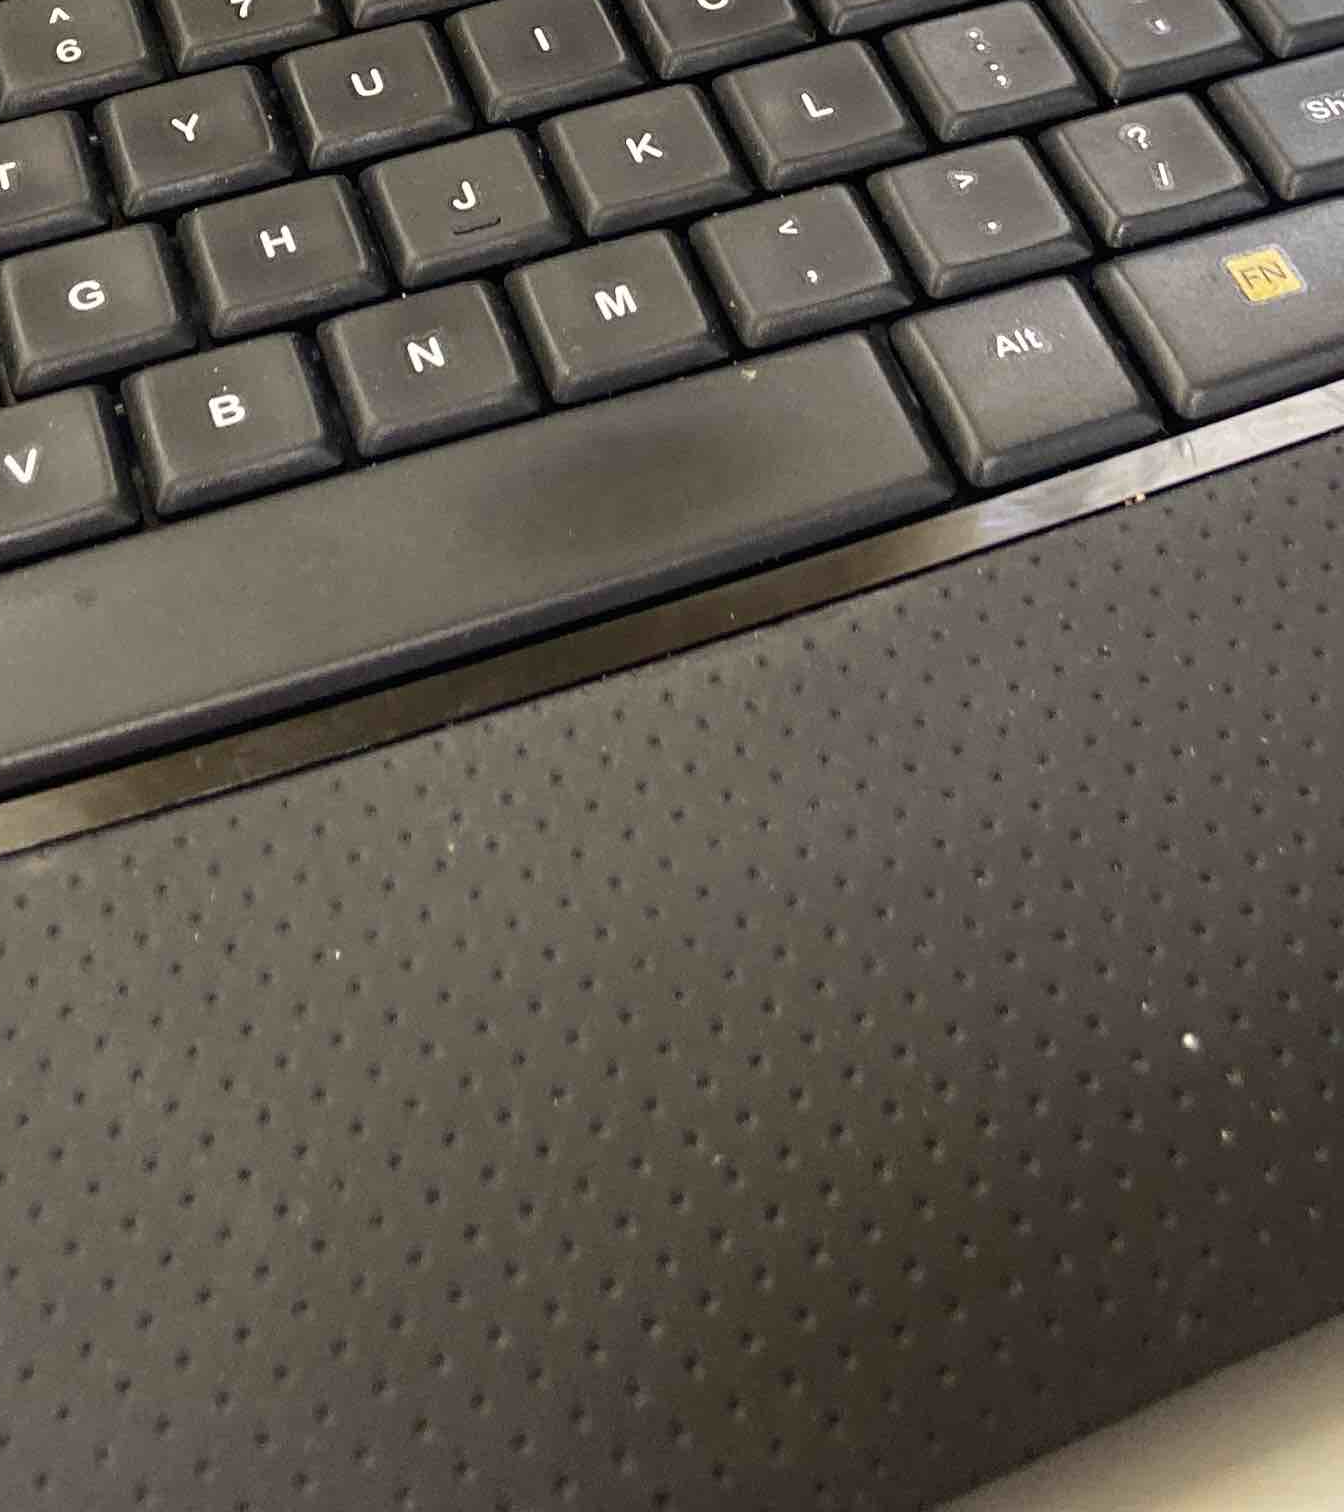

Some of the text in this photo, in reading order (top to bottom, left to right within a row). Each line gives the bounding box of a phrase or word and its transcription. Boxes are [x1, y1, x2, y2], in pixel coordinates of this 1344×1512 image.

[56, 38, 82, 63] 6
[534, 27, 550, 51] I
[350, 68, 384, 97] U
[801, 92, 834, 118] L
[171, 113, 199, 142] Y
[625, 132, 663, 163] K
[452, 180, 477, 210] J
[259, 225, 297, 258] H
[1240, 262, 1289, 288] FN
[68, 279, 106, 311] G
[594, 284, 638, 321] M
[407, 336, 445, 373] N
[996, 327, 1044, 359] Alt
[208, 394, 246, 428] B
[3, 447, 38, 484] V
